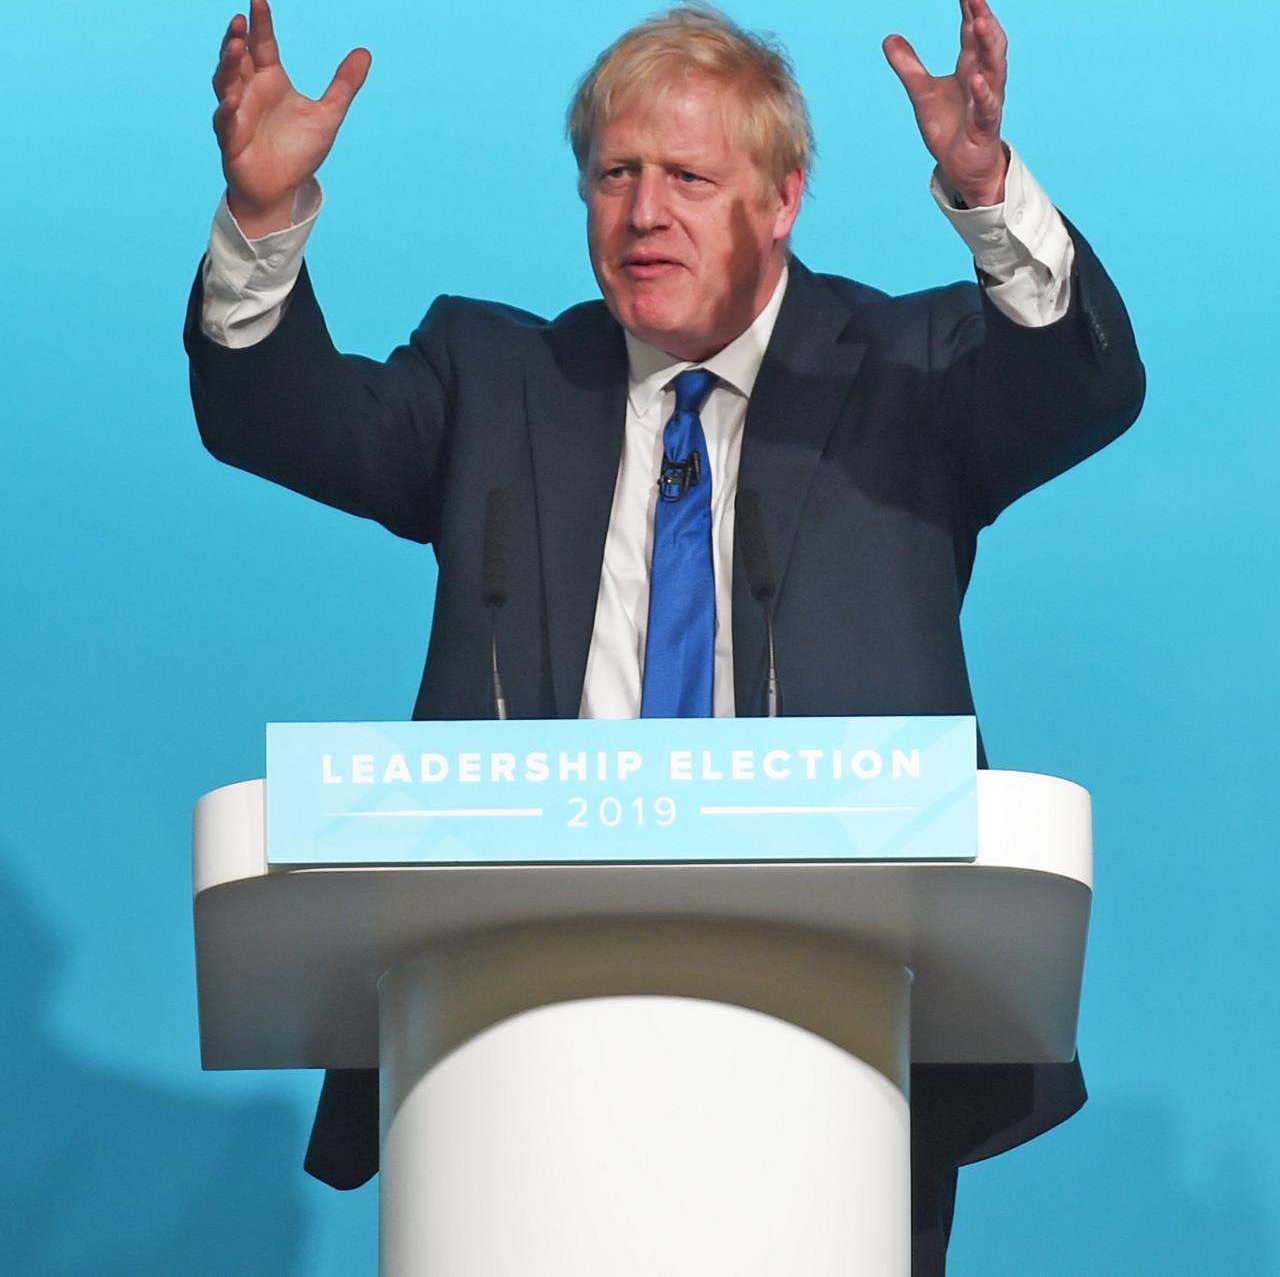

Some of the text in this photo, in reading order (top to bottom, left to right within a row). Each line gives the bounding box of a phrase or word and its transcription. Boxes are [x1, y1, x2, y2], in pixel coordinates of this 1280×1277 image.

[322, 748, 922, 785] LEADERSHIP ELECTION
[567, 796, 677, 828] 2019
